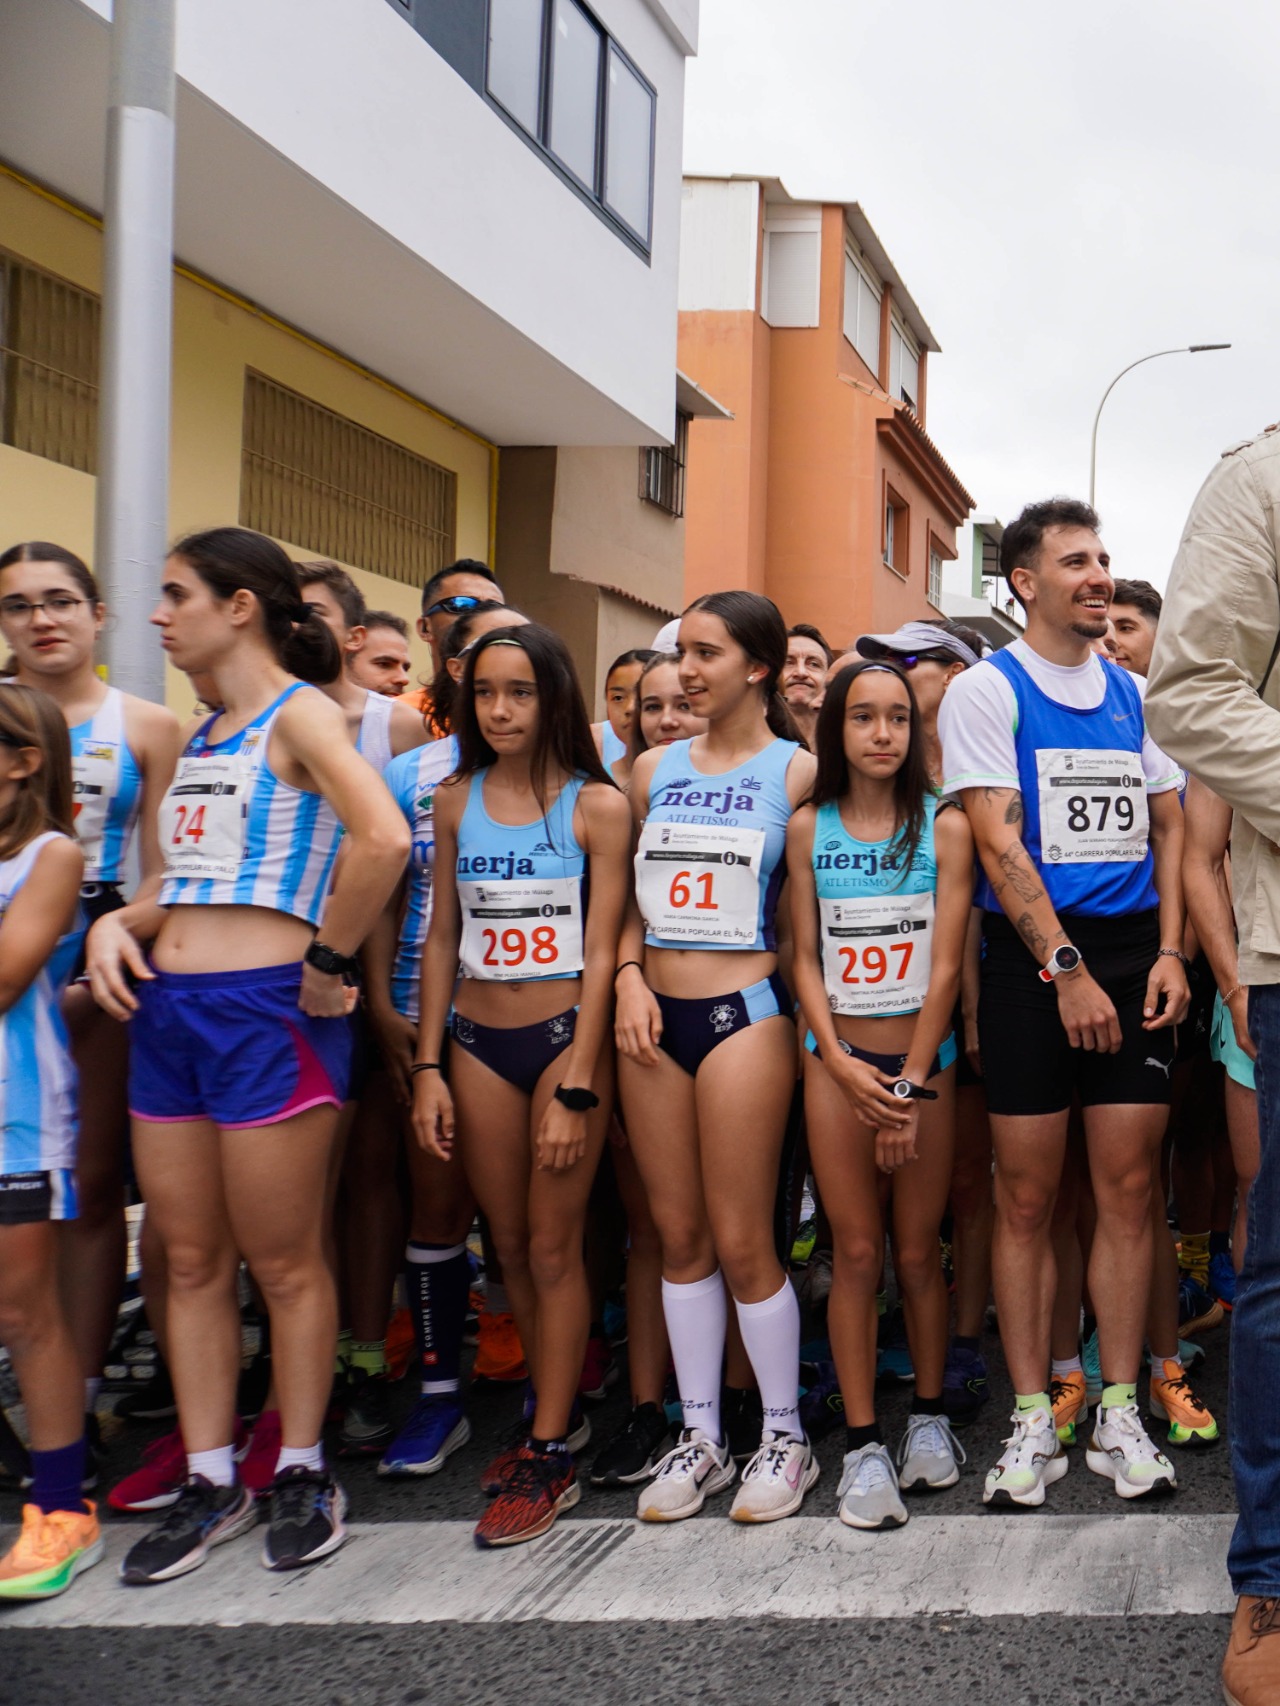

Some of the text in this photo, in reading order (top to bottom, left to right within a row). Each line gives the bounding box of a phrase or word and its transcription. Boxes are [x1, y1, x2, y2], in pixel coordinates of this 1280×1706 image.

[660, 786, 755, 815] nerja
[1067, 795, 1134, 833] 879
[171, 804, 206, 844] 24
[664, 814, 739, 827] ATLETISMO
[457, 851, 536, 880] nerja
[816, 849, 901, 876] nerja
[669, 871, 718, 910] 61
[825, 877, 889, 887] ATLETISMO
[481, 926, 559, 967] 298
[656, 926, 686, 935] CARRERA
[688, 928, 722, 937] POPULAR
[723, 930, 732, 938] EL
[734, 930, 754, 939] PALO
[838, 942, 914, 984] 297
[848, 1001, 876, 1010] CARRERA
[878, 998, 911, 1008] POPULAR
